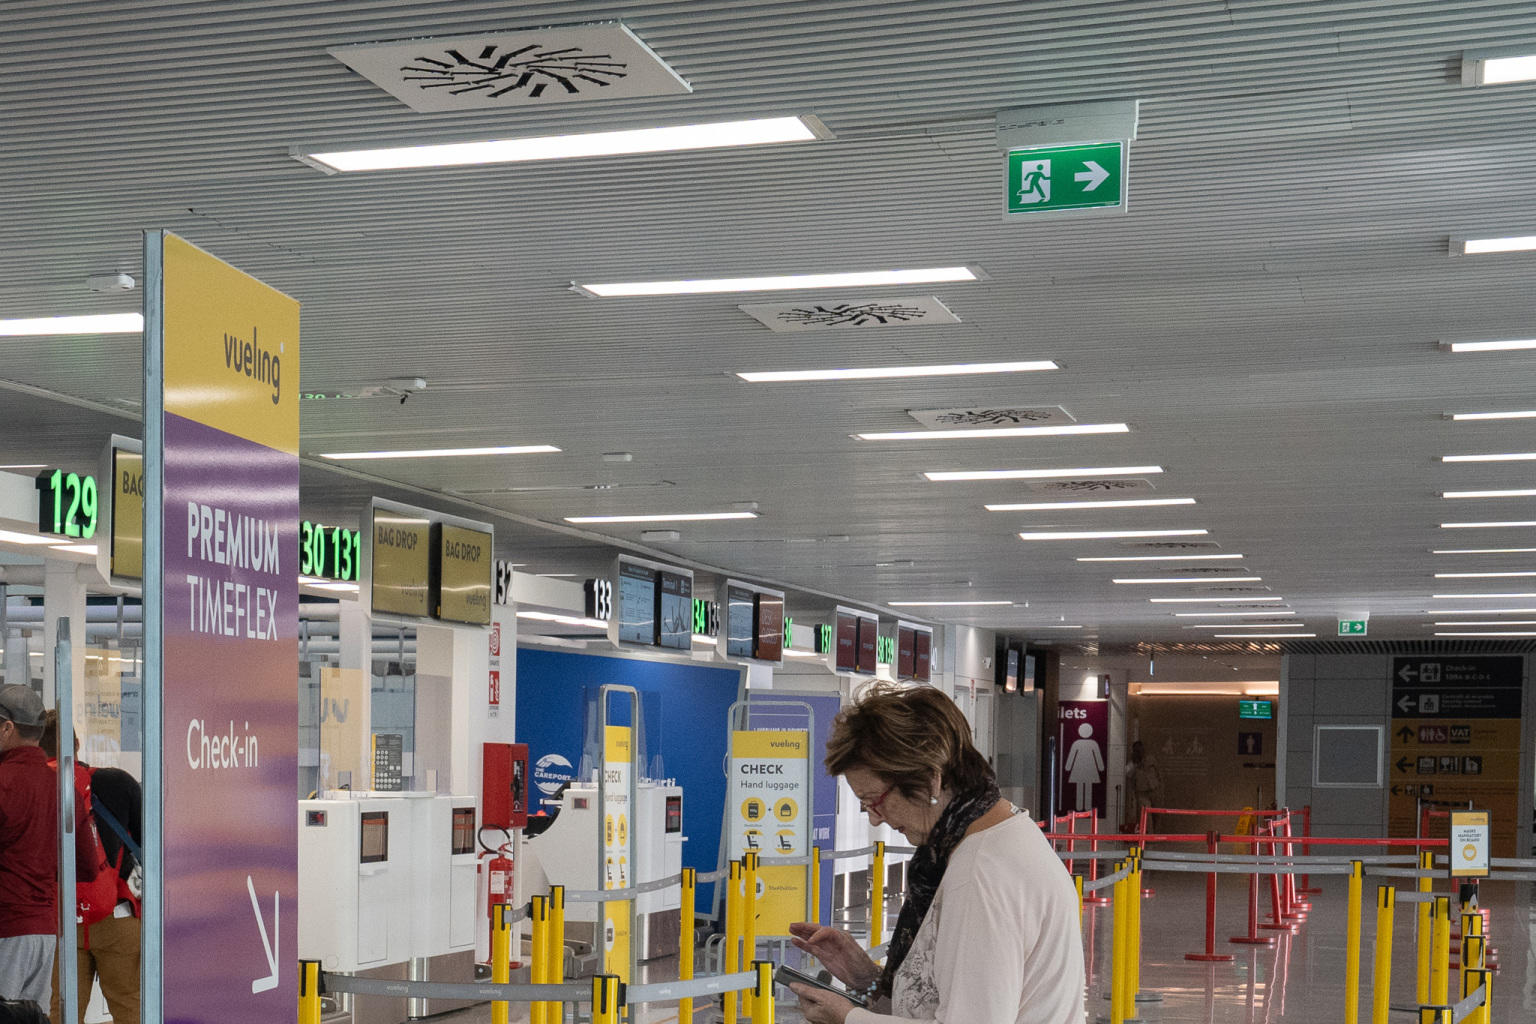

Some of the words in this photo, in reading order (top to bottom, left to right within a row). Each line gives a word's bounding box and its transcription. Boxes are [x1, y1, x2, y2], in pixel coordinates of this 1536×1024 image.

[224, 326, 280, 405] vueling
[50, 468, 98, 539] 129
[187, 501, 280, 575] PREMIUM
[301, 520, 325, 577] 30
[331, 526, 360, 581] 131
[378, 526, 394, 547] BAG
[396, 529, 418, 551] DROP
[445, 540, 460, 559] BAG
[461, 542, 481, 562] DROP
[497, 559, 513, 605] 32
[593, 578, 612, 621] 133
[186, 574, 278, 641] TIMEFLEX
[693, 598, 705, 634] 34
[186, 718, 259, 770] Check-in
[770, 739, 801, 750] vueling
[740, 764, 784, 774] CHECK
[740, 780, 764, 789] Hand
[765, 780, 800, 791] luggage
